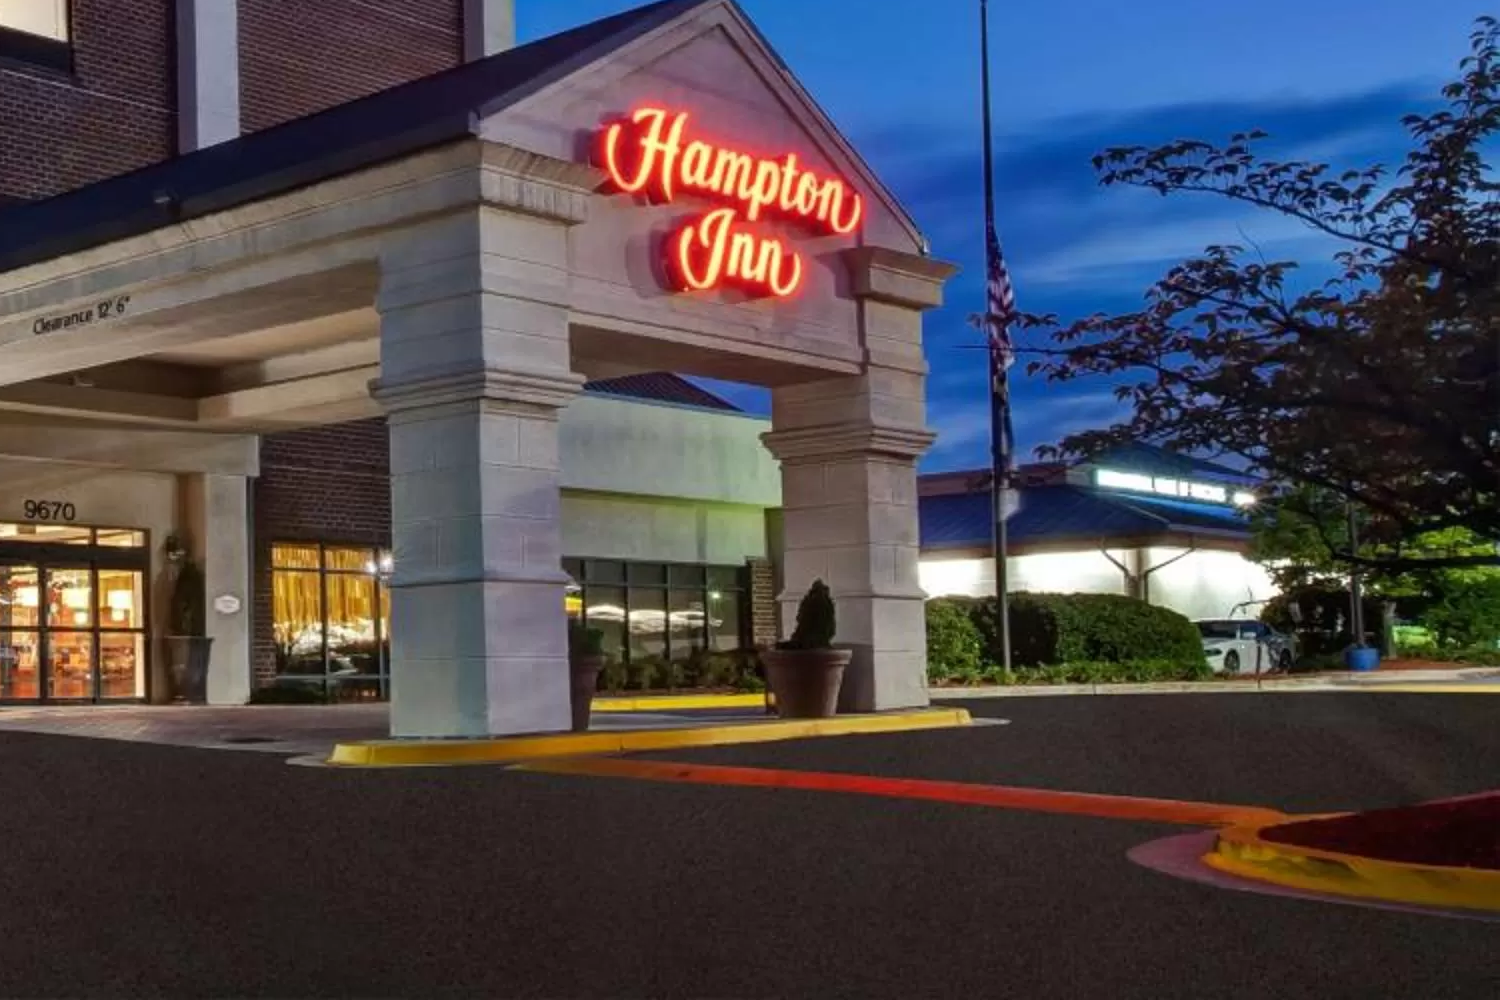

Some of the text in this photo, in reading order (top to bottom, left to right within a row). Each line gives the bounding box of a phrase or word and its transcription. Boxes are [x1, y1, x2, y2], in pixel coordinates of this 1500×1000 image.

[607, 107, 862, 233] Hampton
[679, 207, 801, 296] Inn
[33, 310, 93, 334] Clearance
[23, 499, 76, 521] 9670
